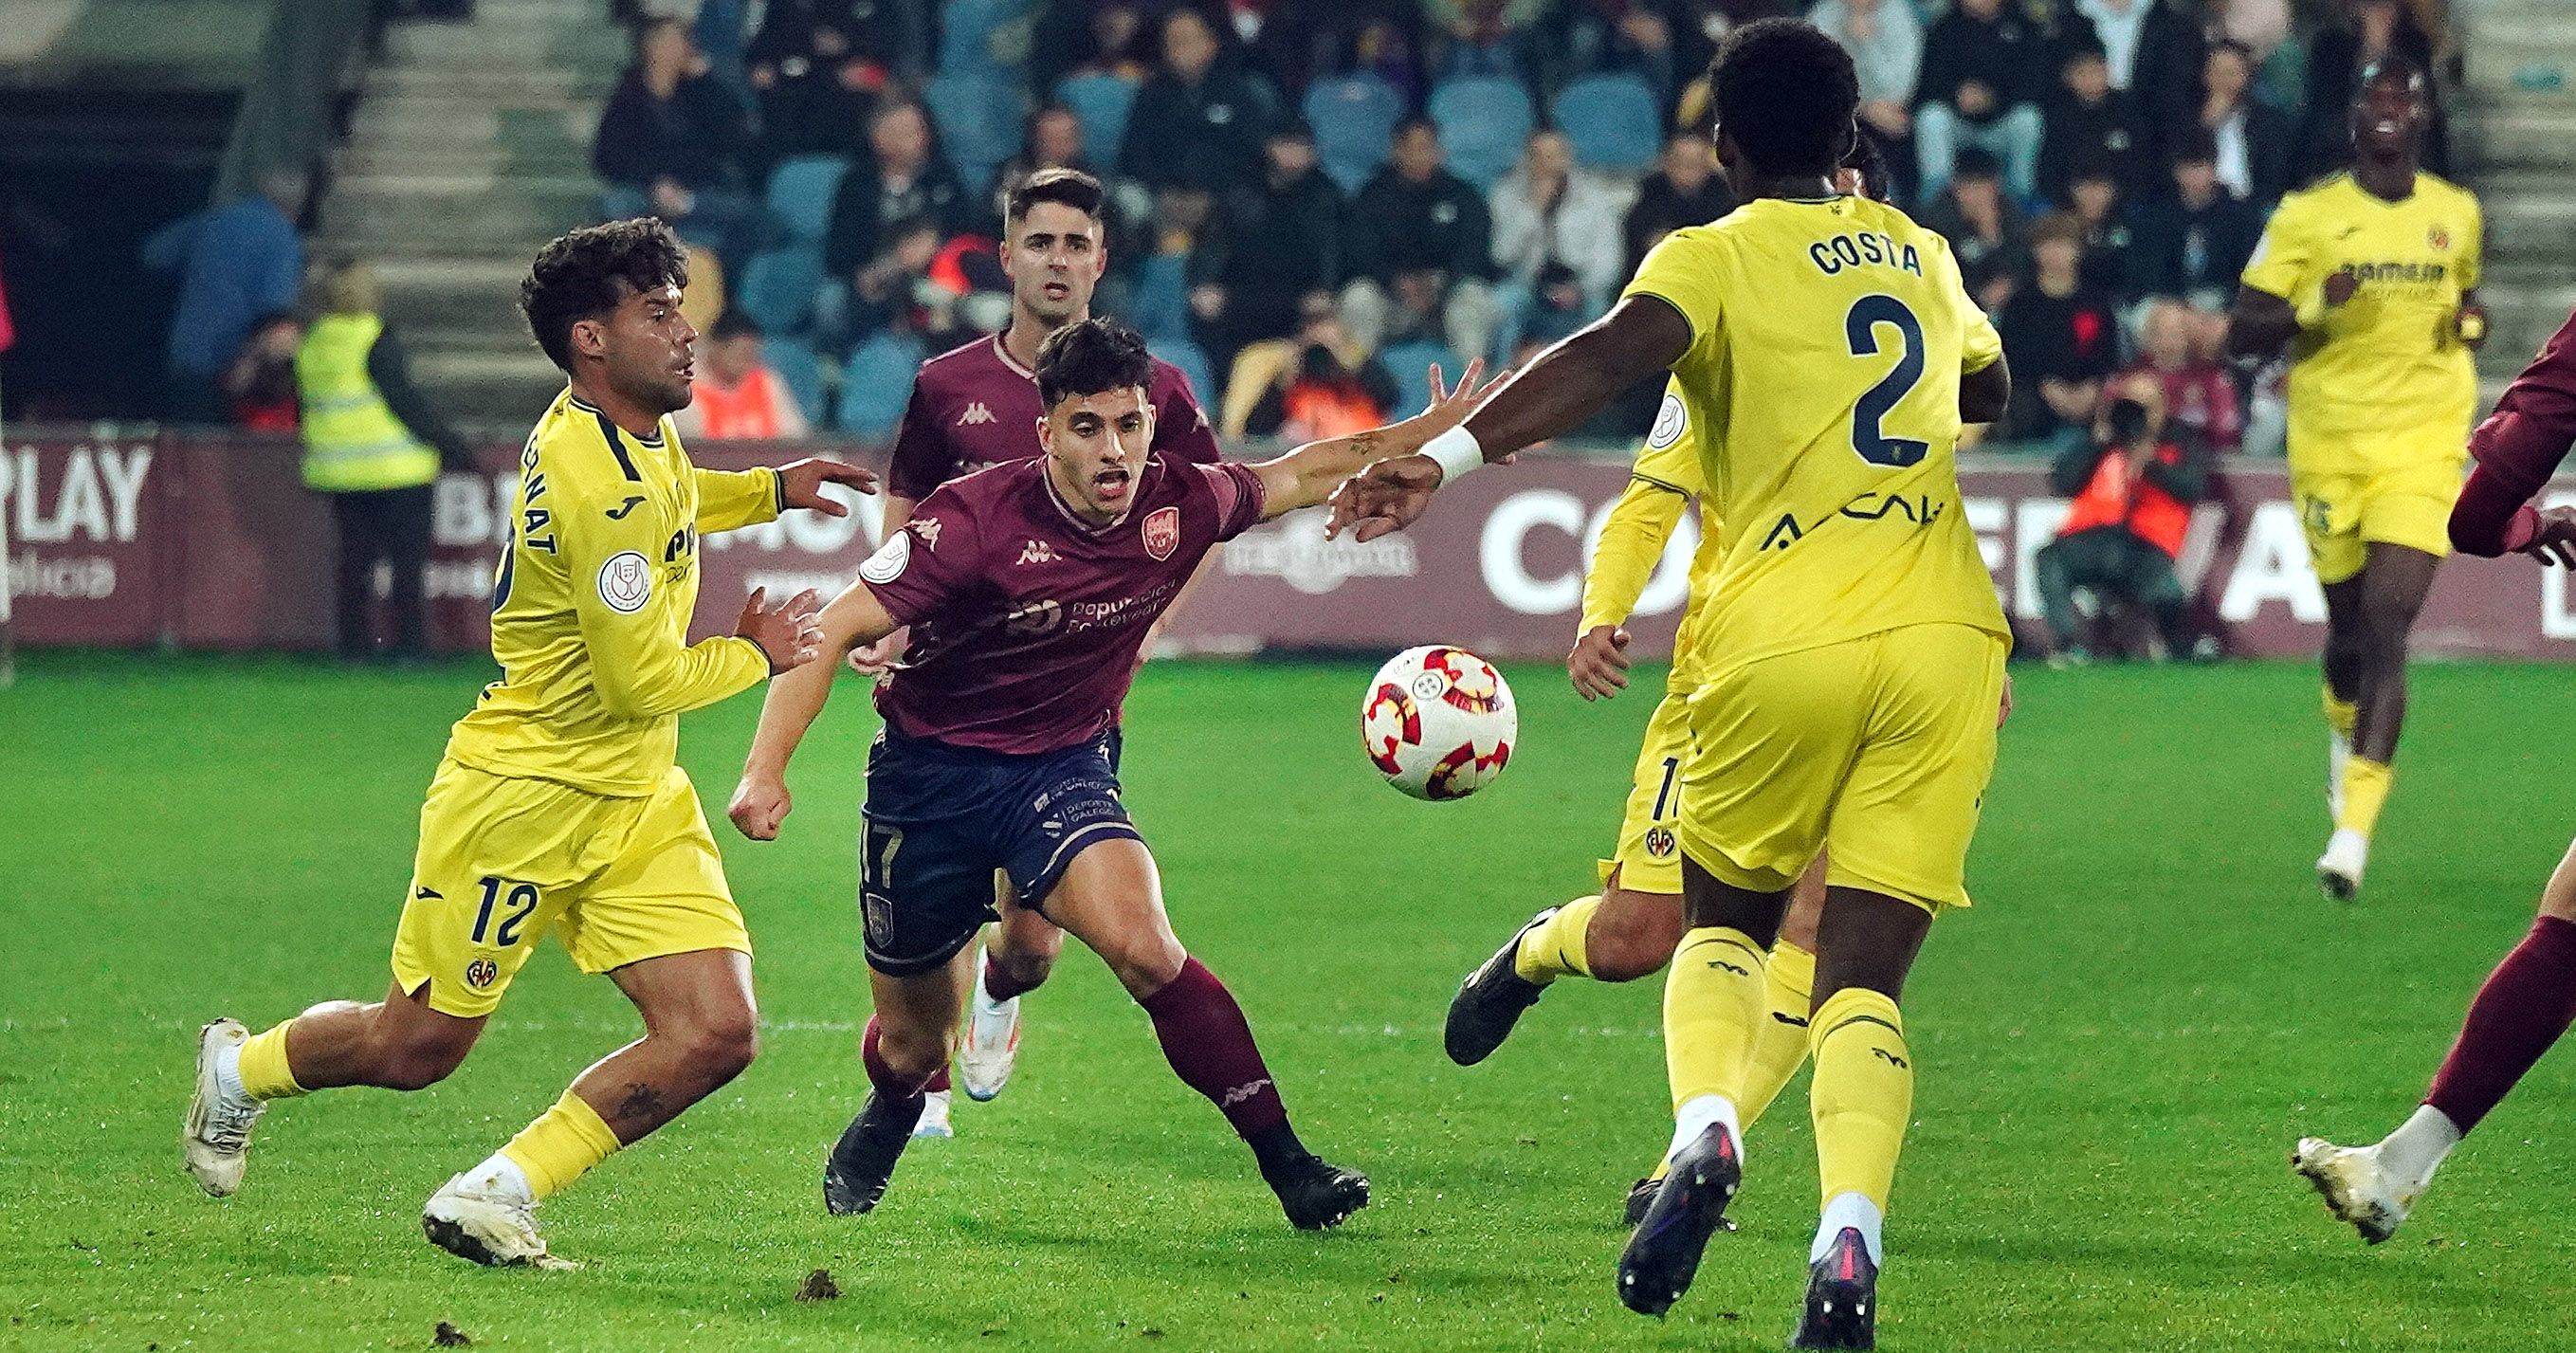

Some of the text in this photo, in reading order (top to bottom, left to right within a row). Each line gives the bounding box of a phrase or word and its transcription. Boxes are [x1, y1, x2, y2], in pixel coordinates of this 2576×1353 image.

[1810, 233, 1923, 277] COSTA
[1846, 294, 1929, 466] 2
[471, 876, 538, 947] 12
